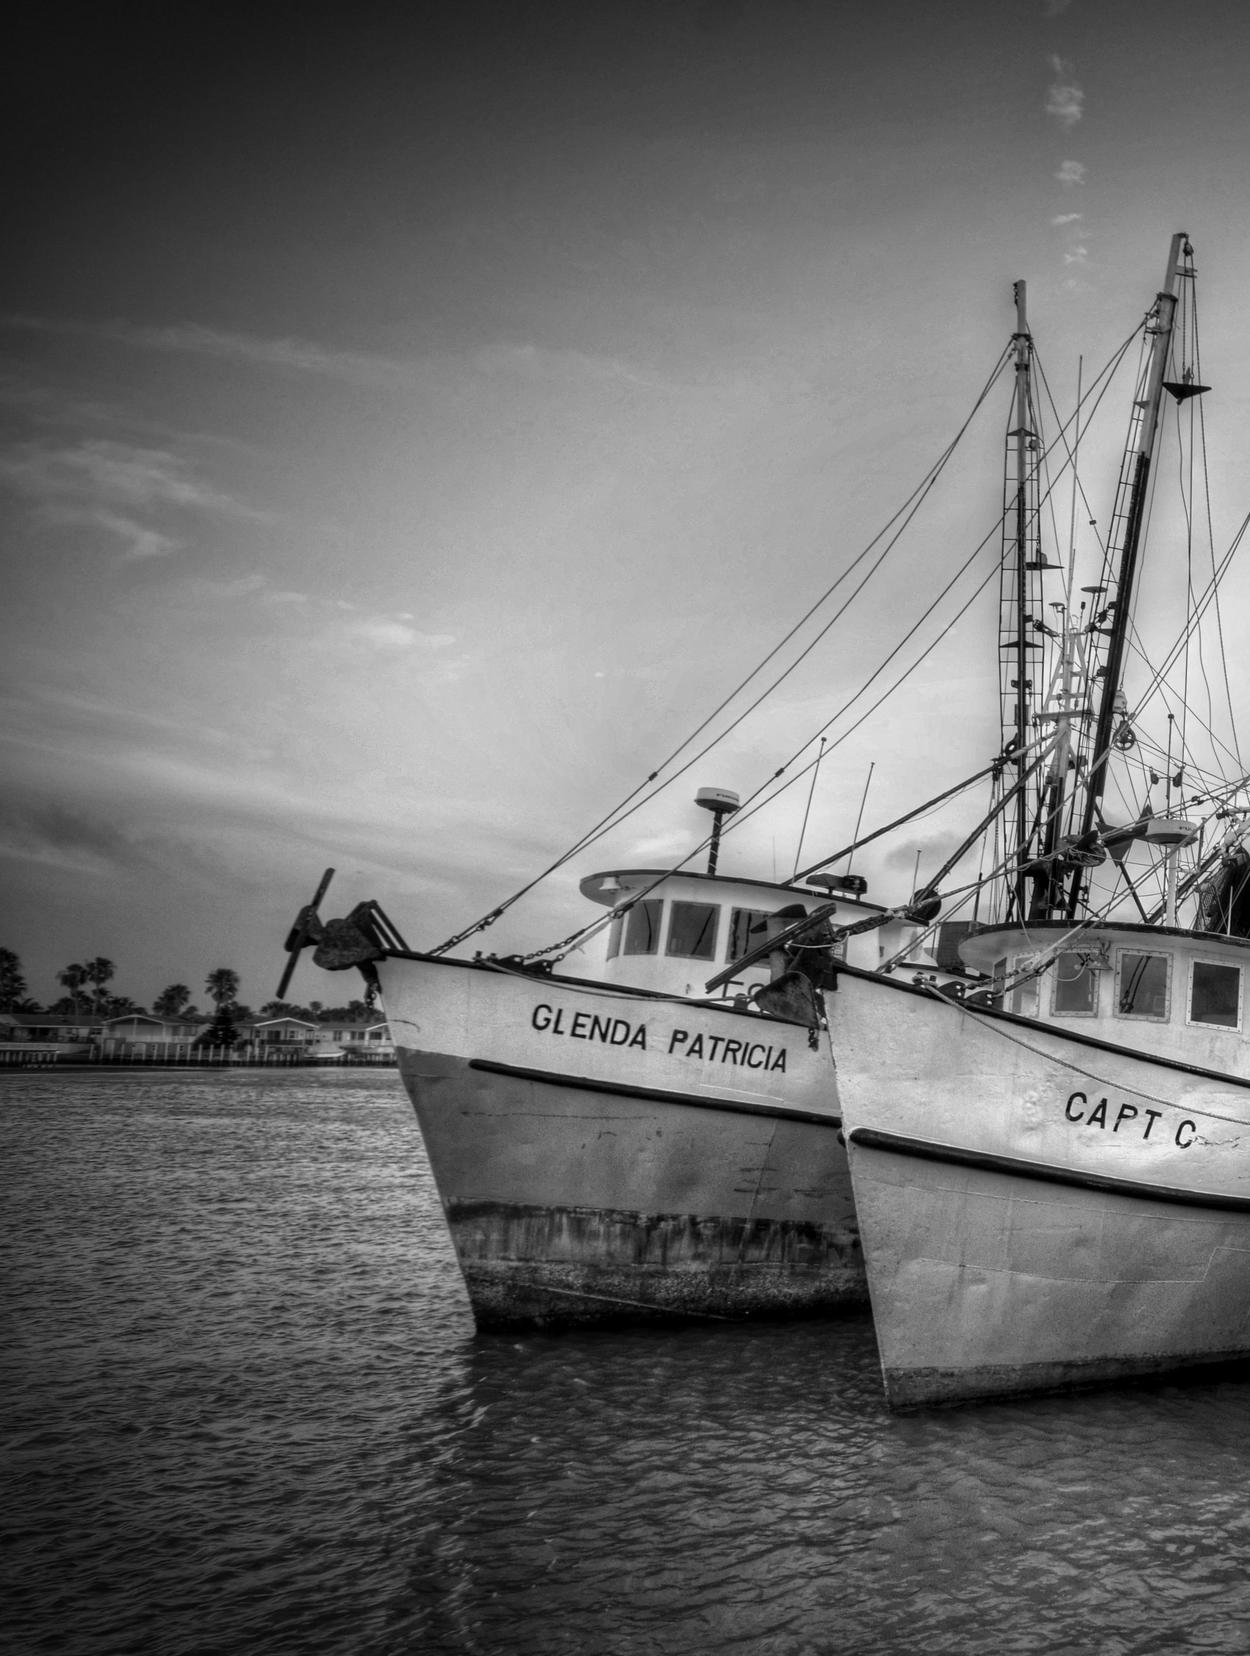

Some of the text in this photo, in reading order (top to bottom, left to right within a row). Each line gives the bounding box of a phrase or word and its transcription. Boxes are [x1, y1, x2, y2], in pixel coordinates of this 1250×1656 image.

[531, 1003, 787, 1073] GLENDA PATRICIA
[1065, 1091, 1197, 1149] CAPT C
